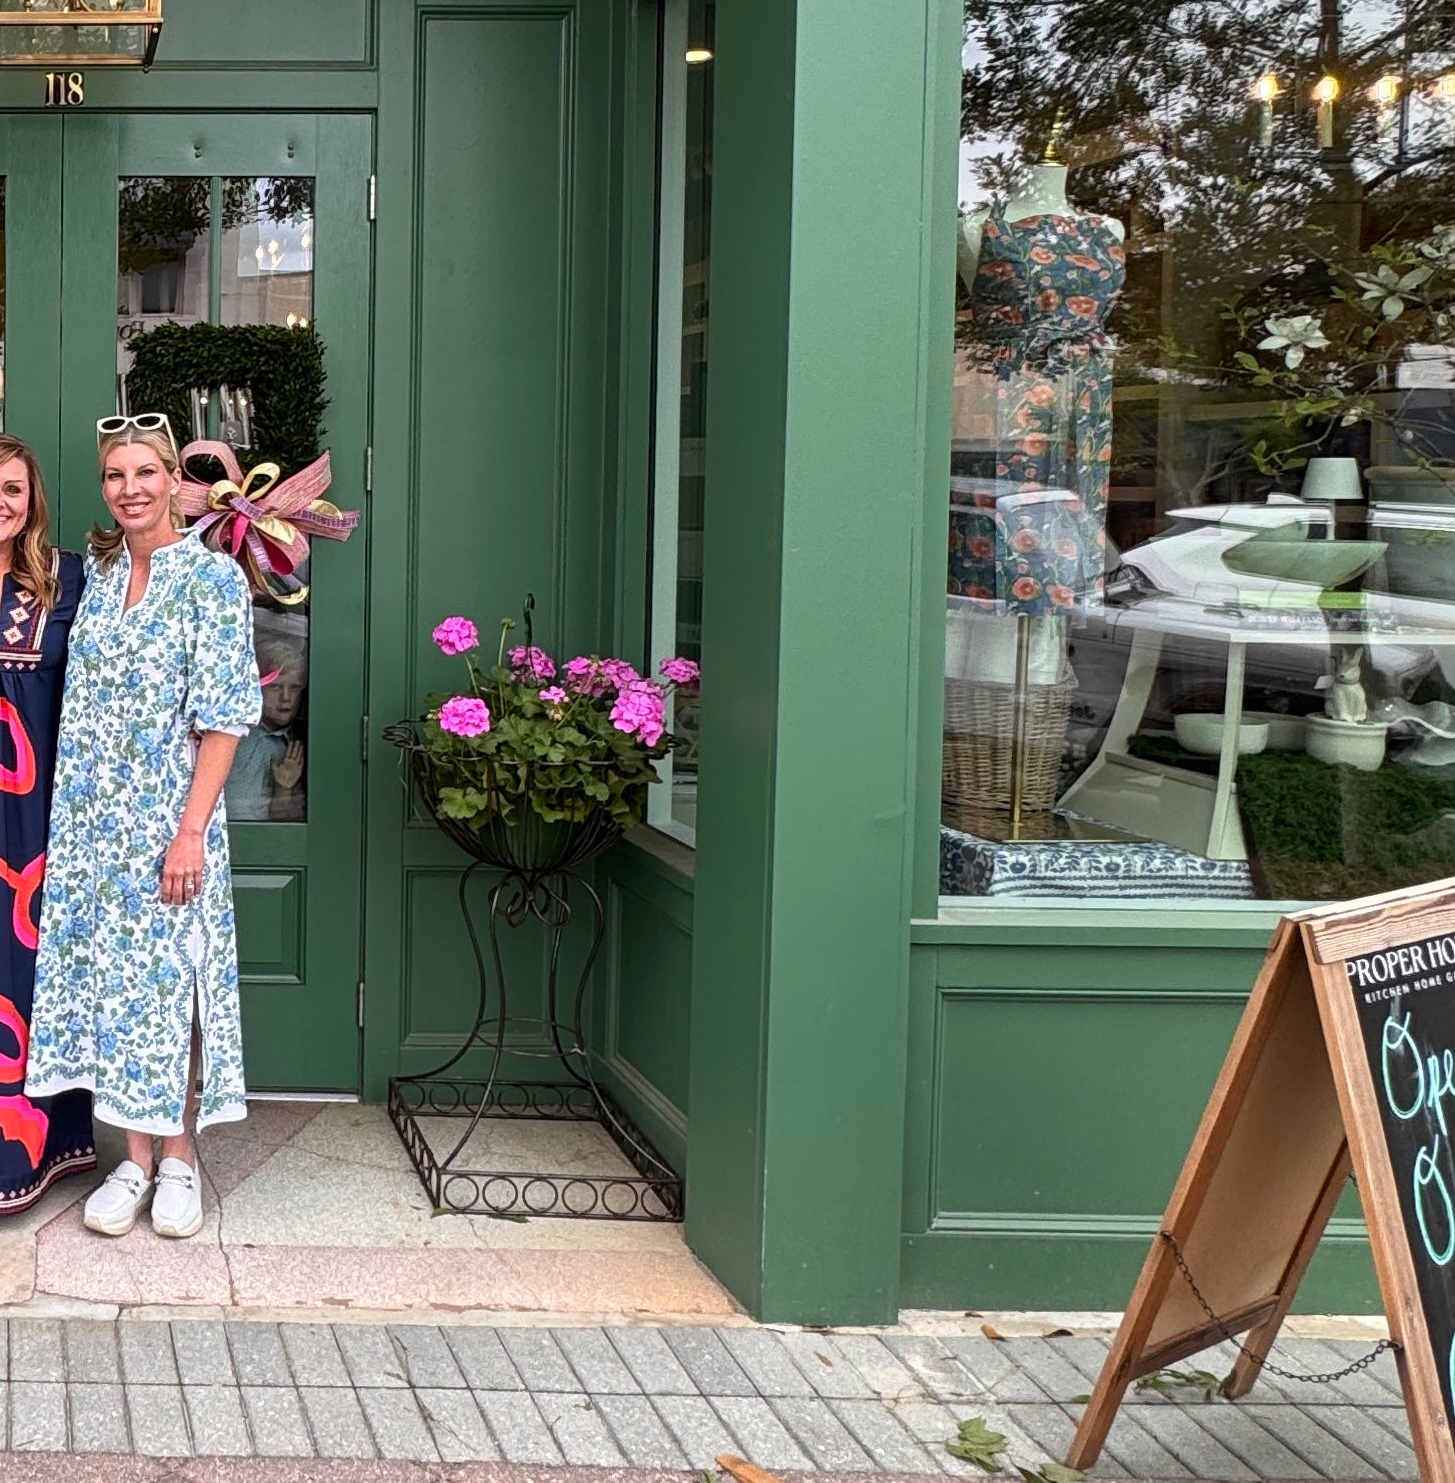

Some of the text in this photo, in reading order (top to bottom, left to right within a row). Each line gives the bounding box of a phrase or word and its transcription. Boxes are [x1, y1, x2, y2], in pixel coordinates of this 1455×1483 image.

[45, 72, 84, 106] 118
[1346, 936, 1455, 987] PROPER HO
[1365, 983, 1410, 1004] KITCHEN
[1413, 974, 1442, 991] HOME
